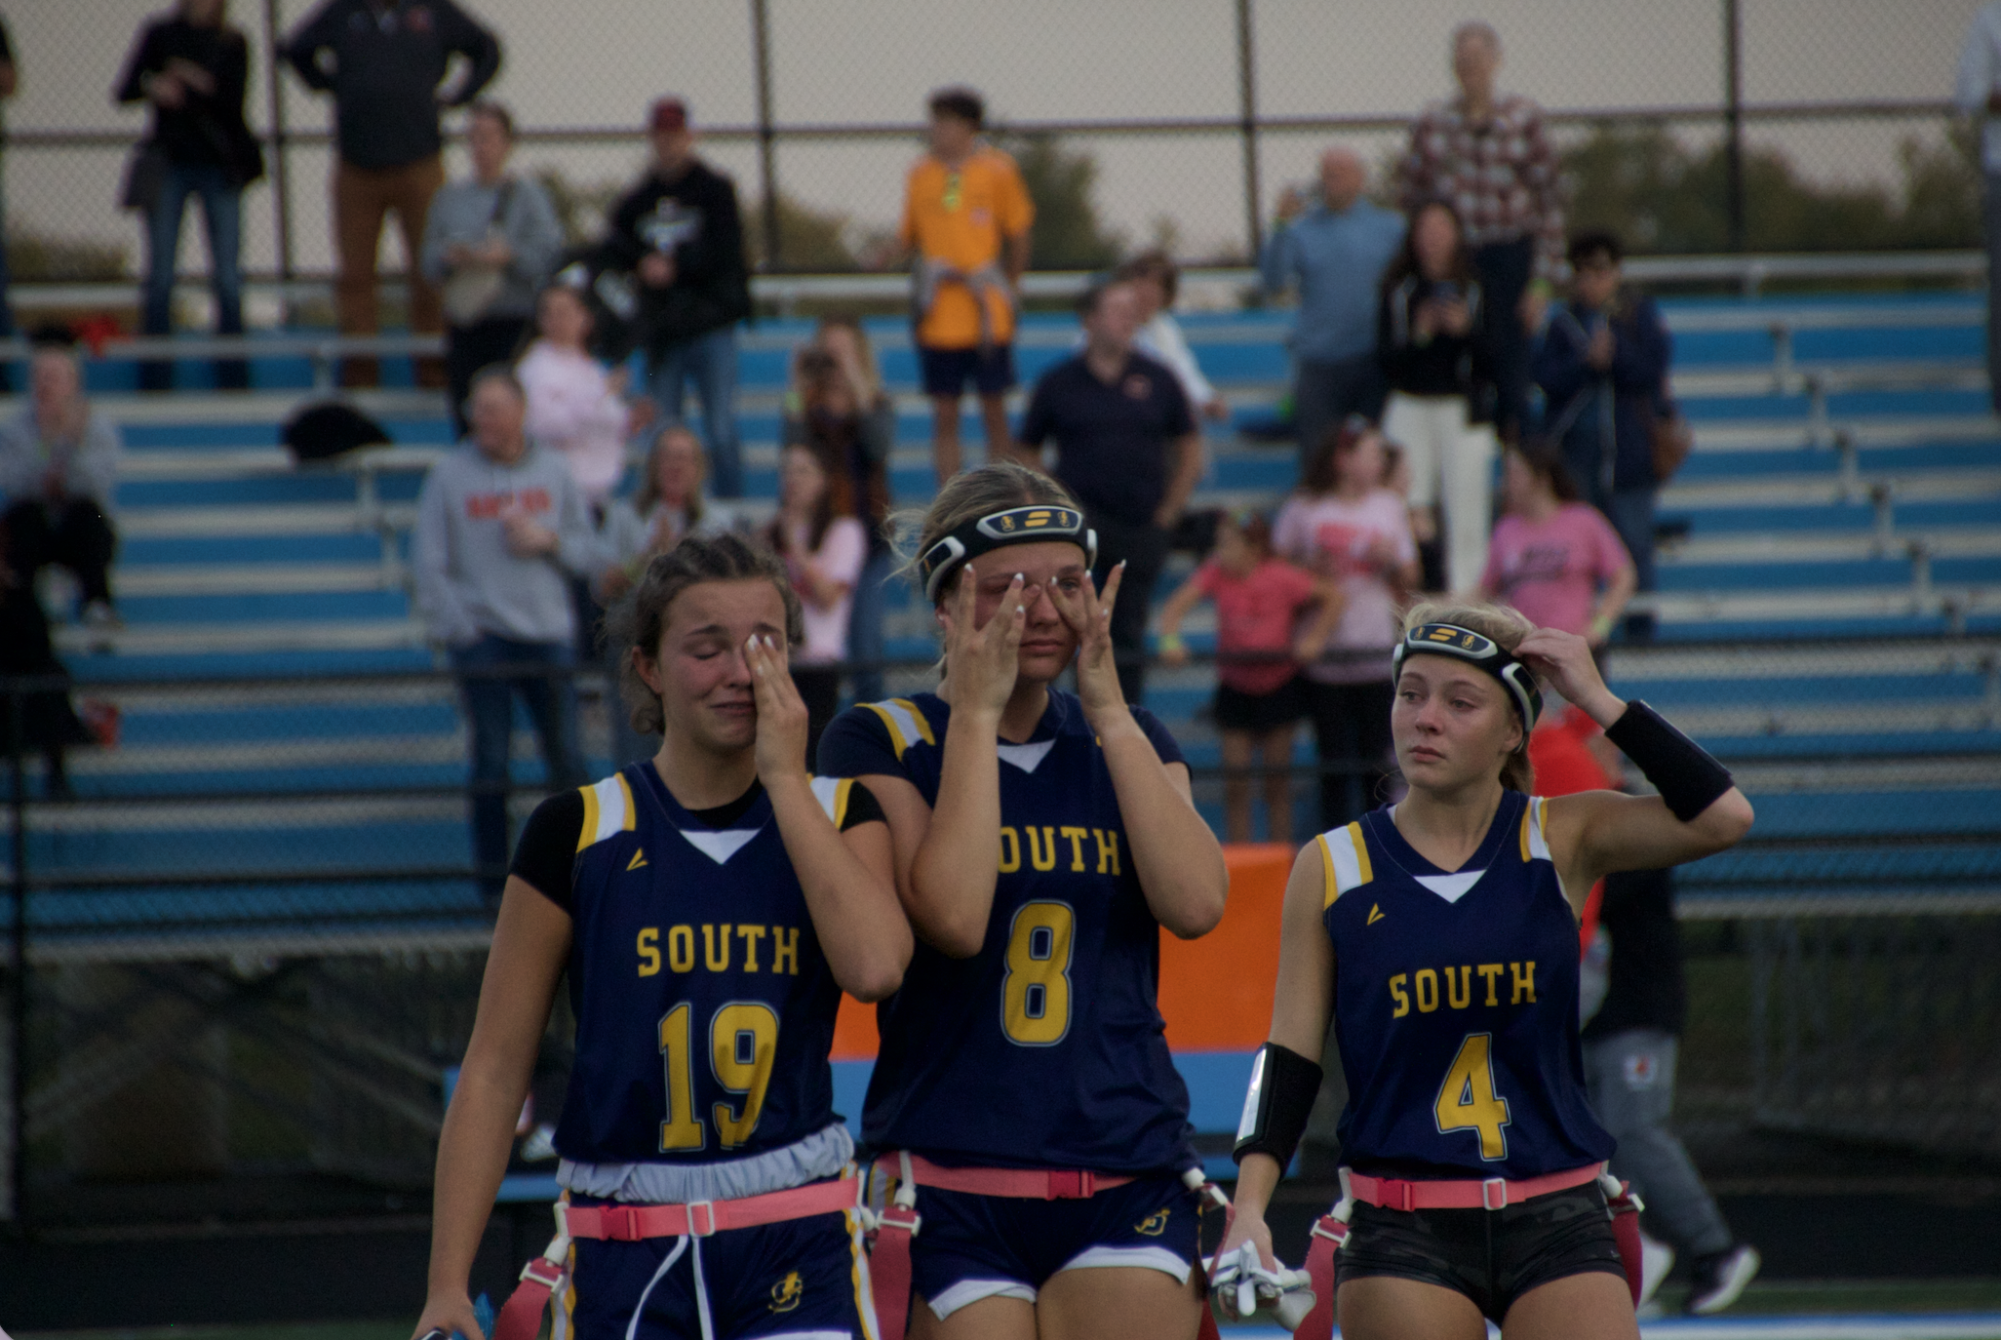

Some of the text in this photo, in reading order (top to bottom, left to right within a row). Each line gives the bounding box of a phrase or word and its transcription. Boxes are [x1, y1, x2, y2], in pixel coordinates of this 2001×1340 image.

[998, 826, 1121, 876] OUTH
[637, 923, 800, 977] SOUTH
[1000, 899, 1076, 1047] 8
[1389, 961, 1537, 1019] SOUTH
[658, 1001, 781, 1153] 19
[1433, 1031, 1512, 1162] 4
